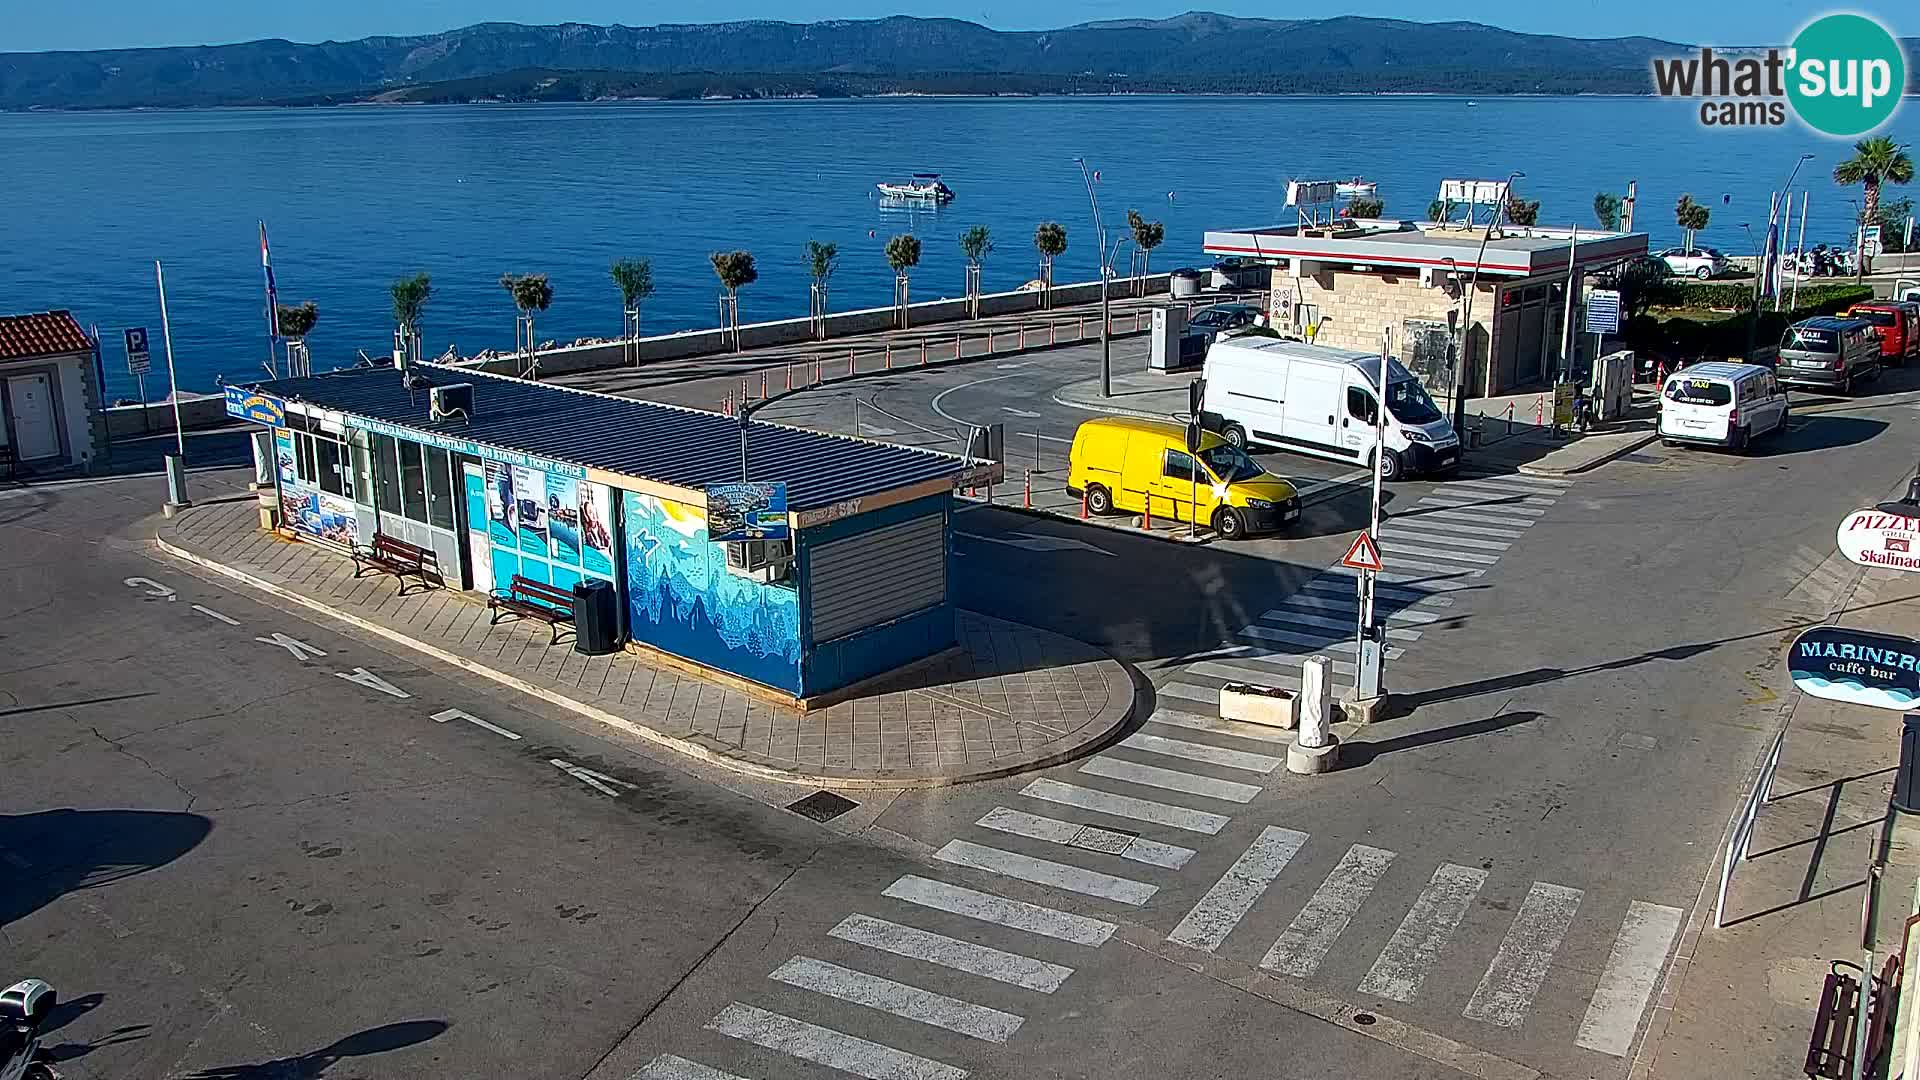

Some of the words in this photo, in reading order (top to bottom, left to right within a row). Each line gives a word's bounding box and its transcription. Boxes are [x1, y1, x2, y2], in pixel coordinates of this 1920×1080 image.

[1691, 380, 1709, 389] TAXI
[436, 436, 468, 452] POSTAJA
[477, 446, 493, 457] BUS
[494, 449, 526, 466] STATION
[528, 457, 553, 472] TICKET
[555, 462, 582, 477] OFFICE
[1848, 515, 1920, 533] PIZZE
[1882, 530, 1916, 540] GRILL
[1829, 661, 1866, 675] caffe
[1870, 665, 1897, 680] bar
